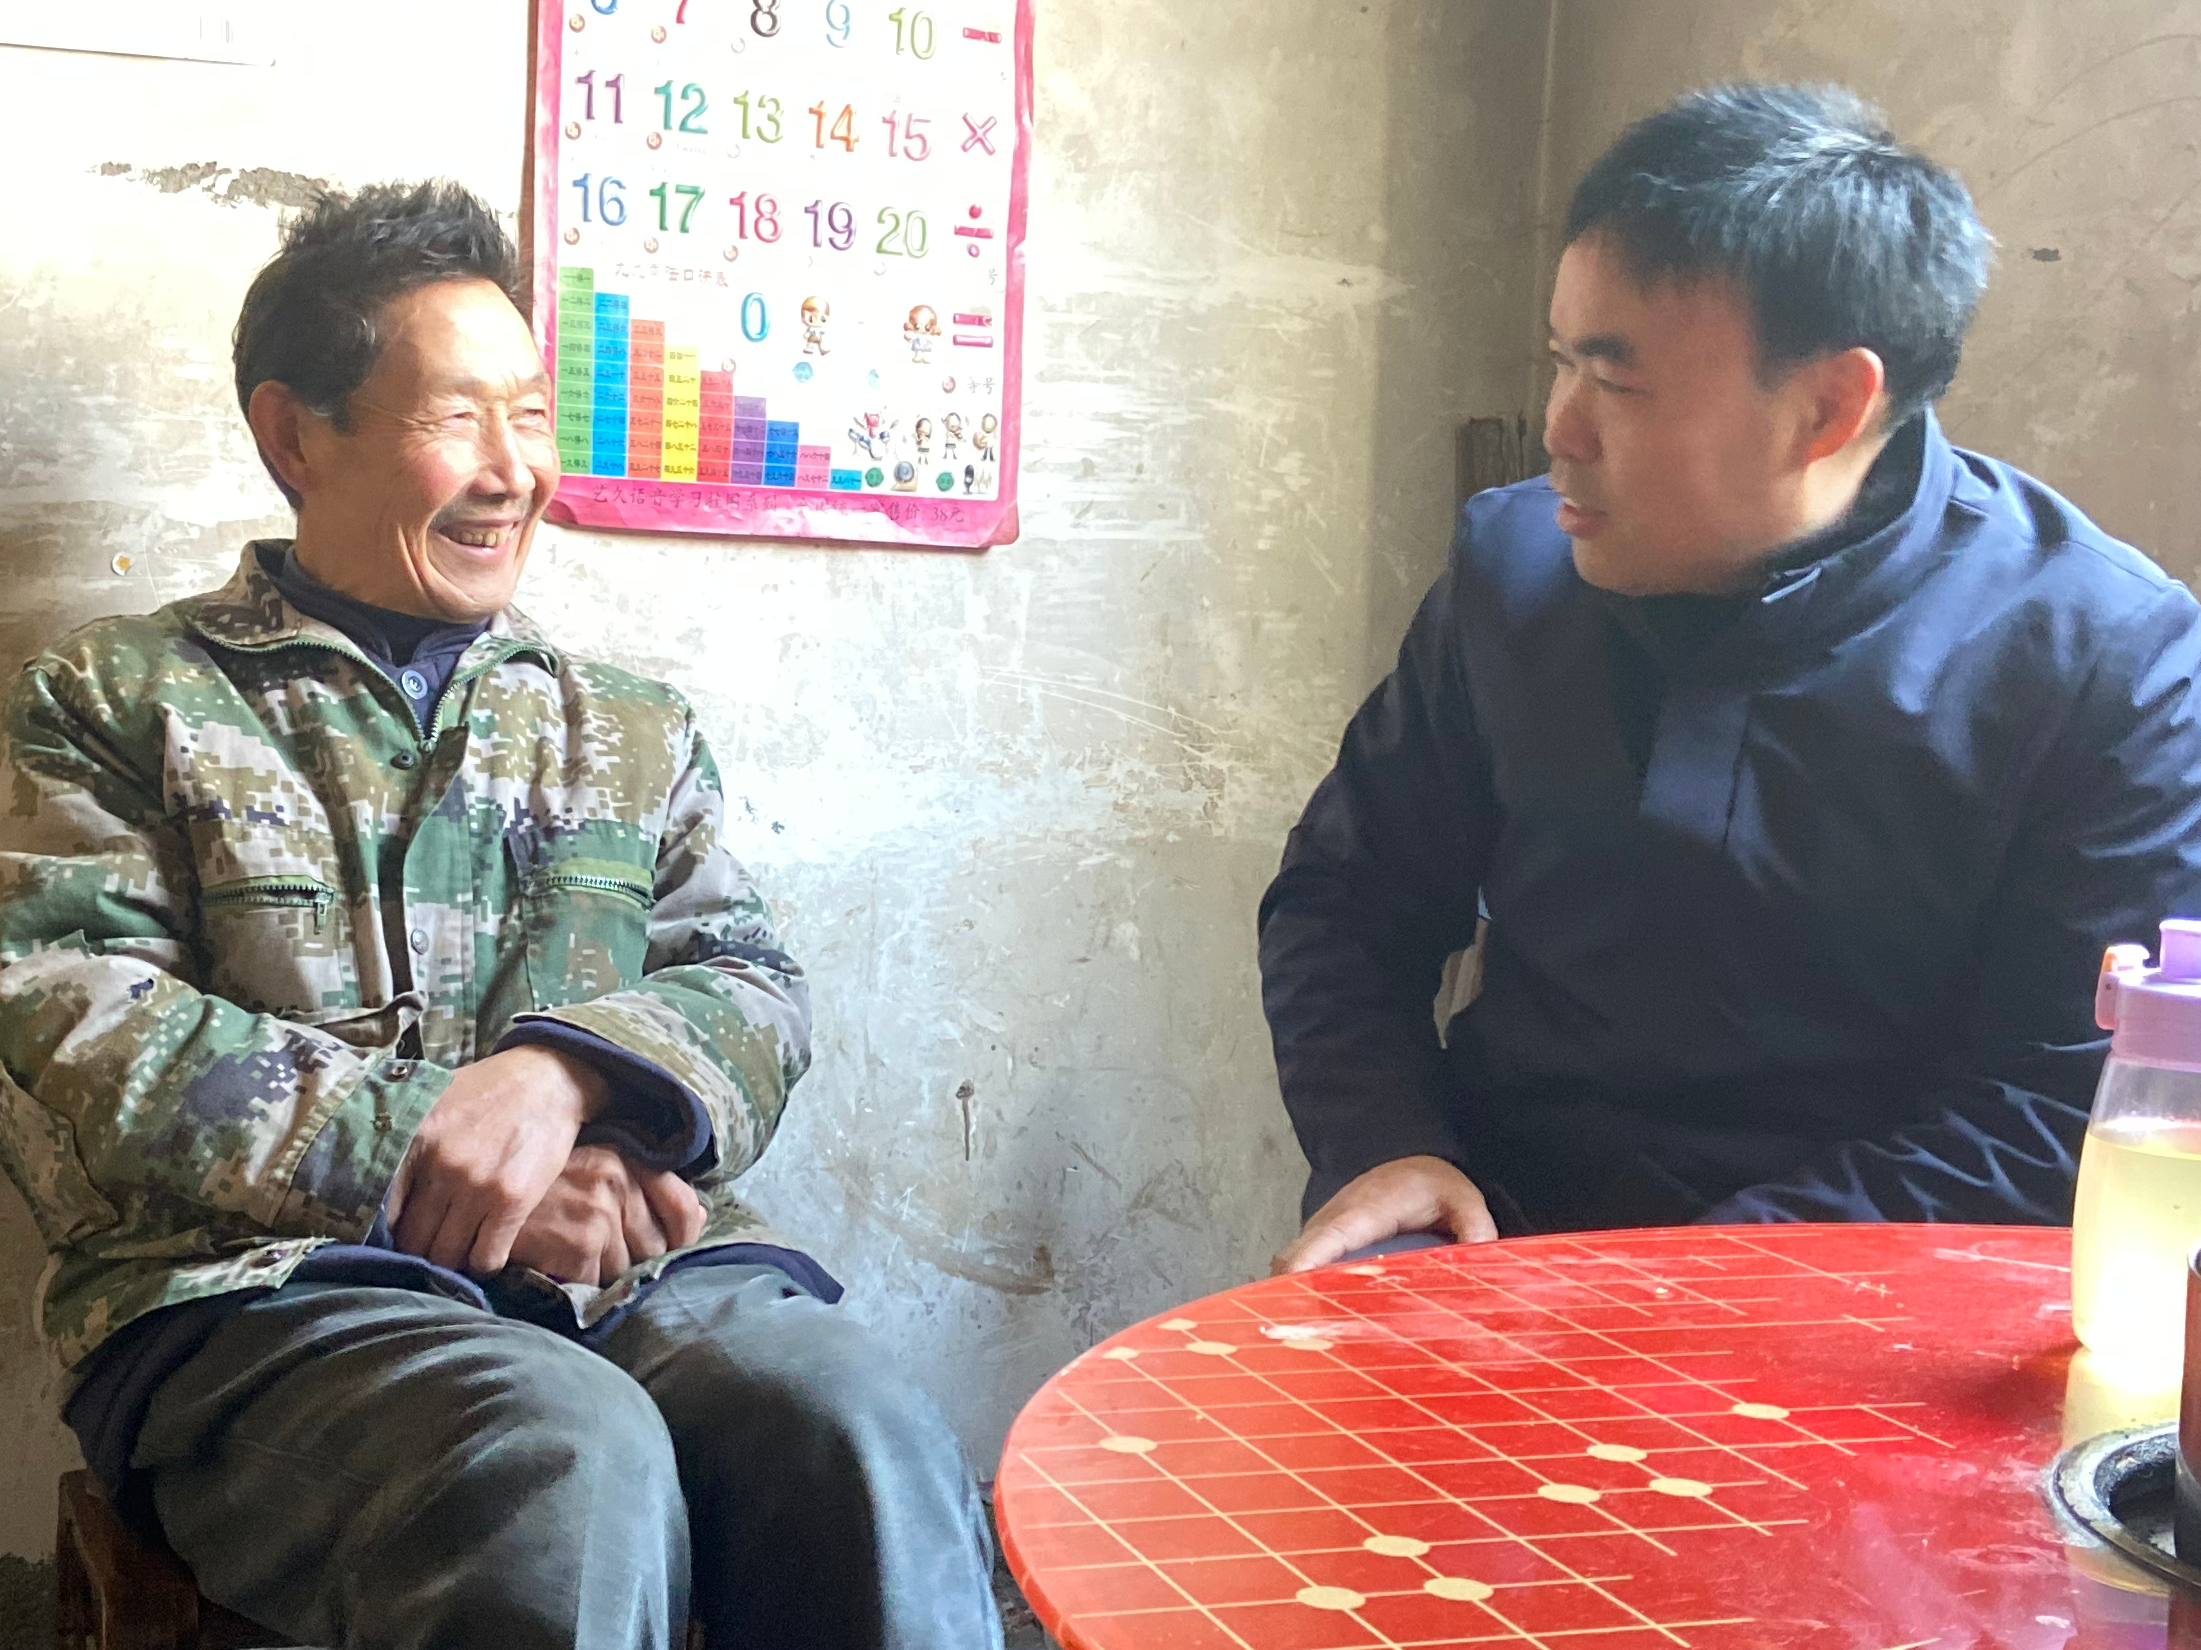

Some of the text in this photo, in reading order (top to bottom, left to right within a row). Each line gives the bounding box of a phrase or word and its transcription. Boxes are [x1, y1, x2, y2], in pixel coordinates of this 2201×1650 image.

[750, 0, 781, 37] 8
[825, 0, 850, 48] 9
[889, 7, 936, 60] 10
[575, 70, 625, 124] 11
[654, 80, 708, 134] 12
[733, 90, 784, 143] 13
[808, 99, 859, 152] 14
[882, 109, 931, 161] 15
[572, 173, 627, 226] 16
[649, 182, 706, 233] 17
[729, 191, 782, 243] 18
[804, 199, 857, 251] 19
[876, 206, 930, 258] 20
[740, 291, 771, 342] 0
[932, 506, 964, 523] 38元
